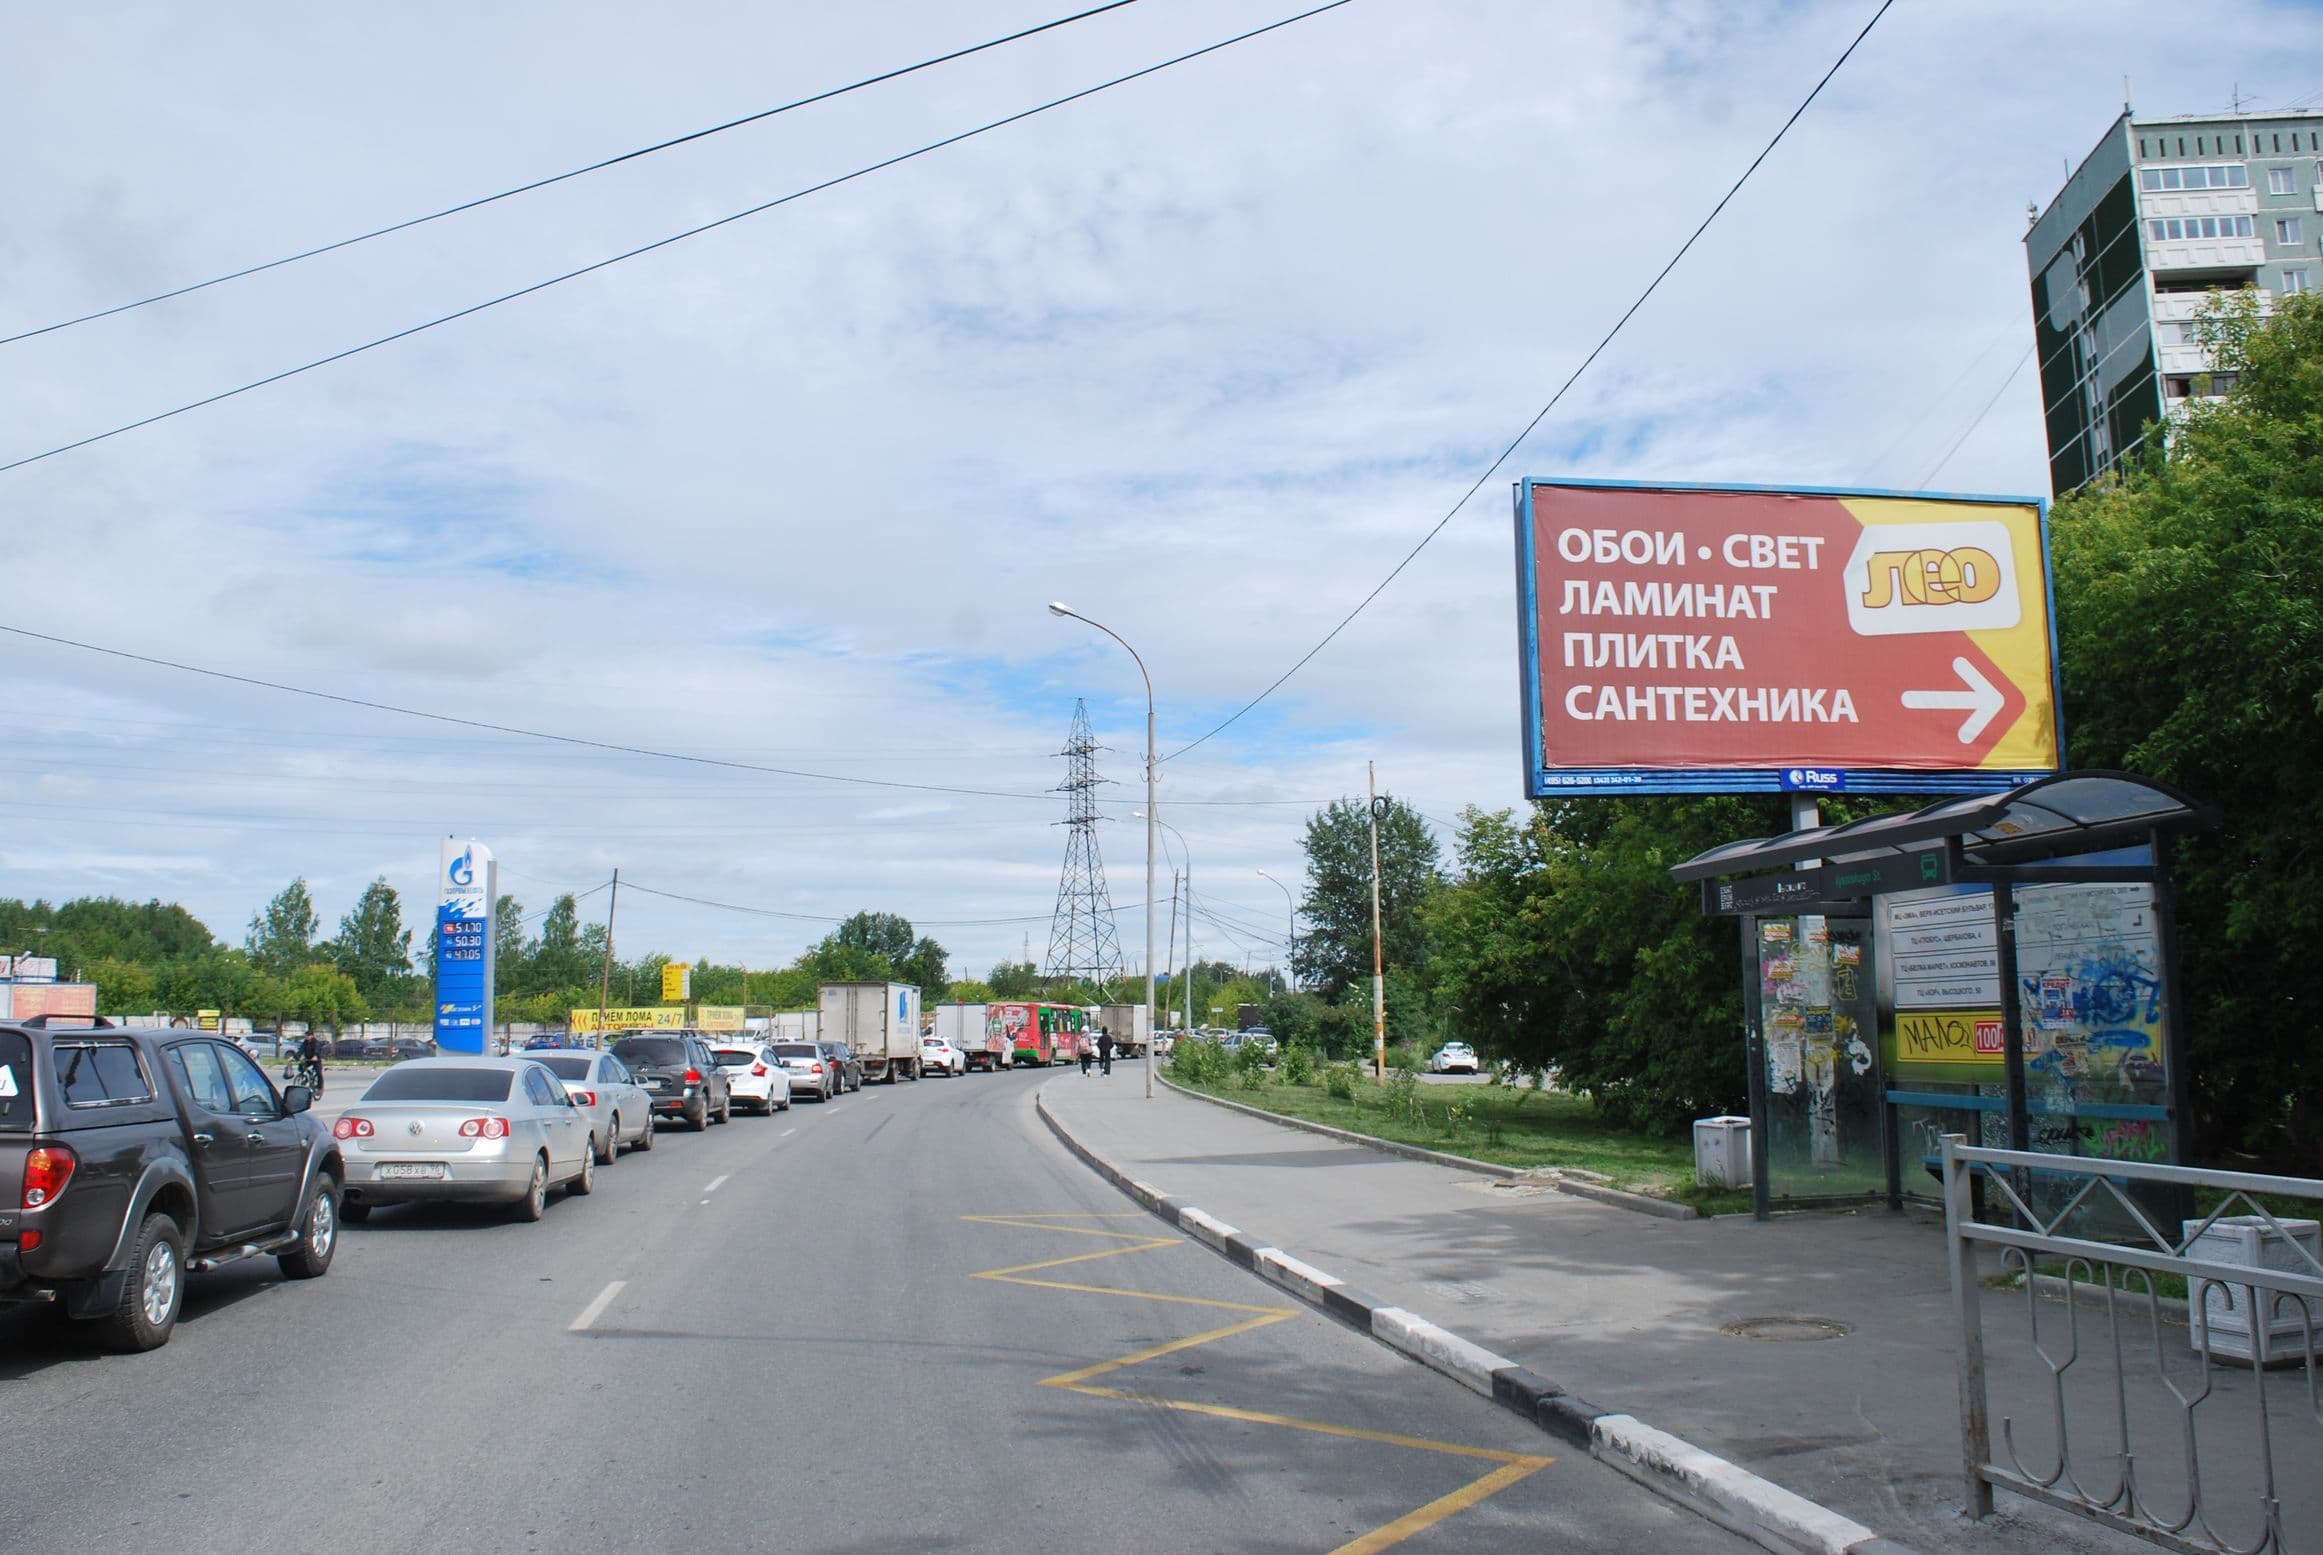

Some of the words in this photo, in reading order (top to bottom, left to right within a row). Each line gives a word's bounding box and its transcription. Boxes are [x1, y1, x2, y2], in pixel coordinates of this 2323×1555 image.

[1557, 527, 1686, 566] ОБОИ
[1722, 533, 1825, 571] СВЕТ
[1559, 580, 1778, 620] ЛАМИНАТ
[1563, 632, 1745, 670] ПЛИТКА
[1564, 684, 1859, 723] САНТЕХНИКА
[1805, 770, 1838, 783] Russ
[626, 1010, 652, 1022] ЛОМА
[657, 1012, 683, 1027] 24/7
